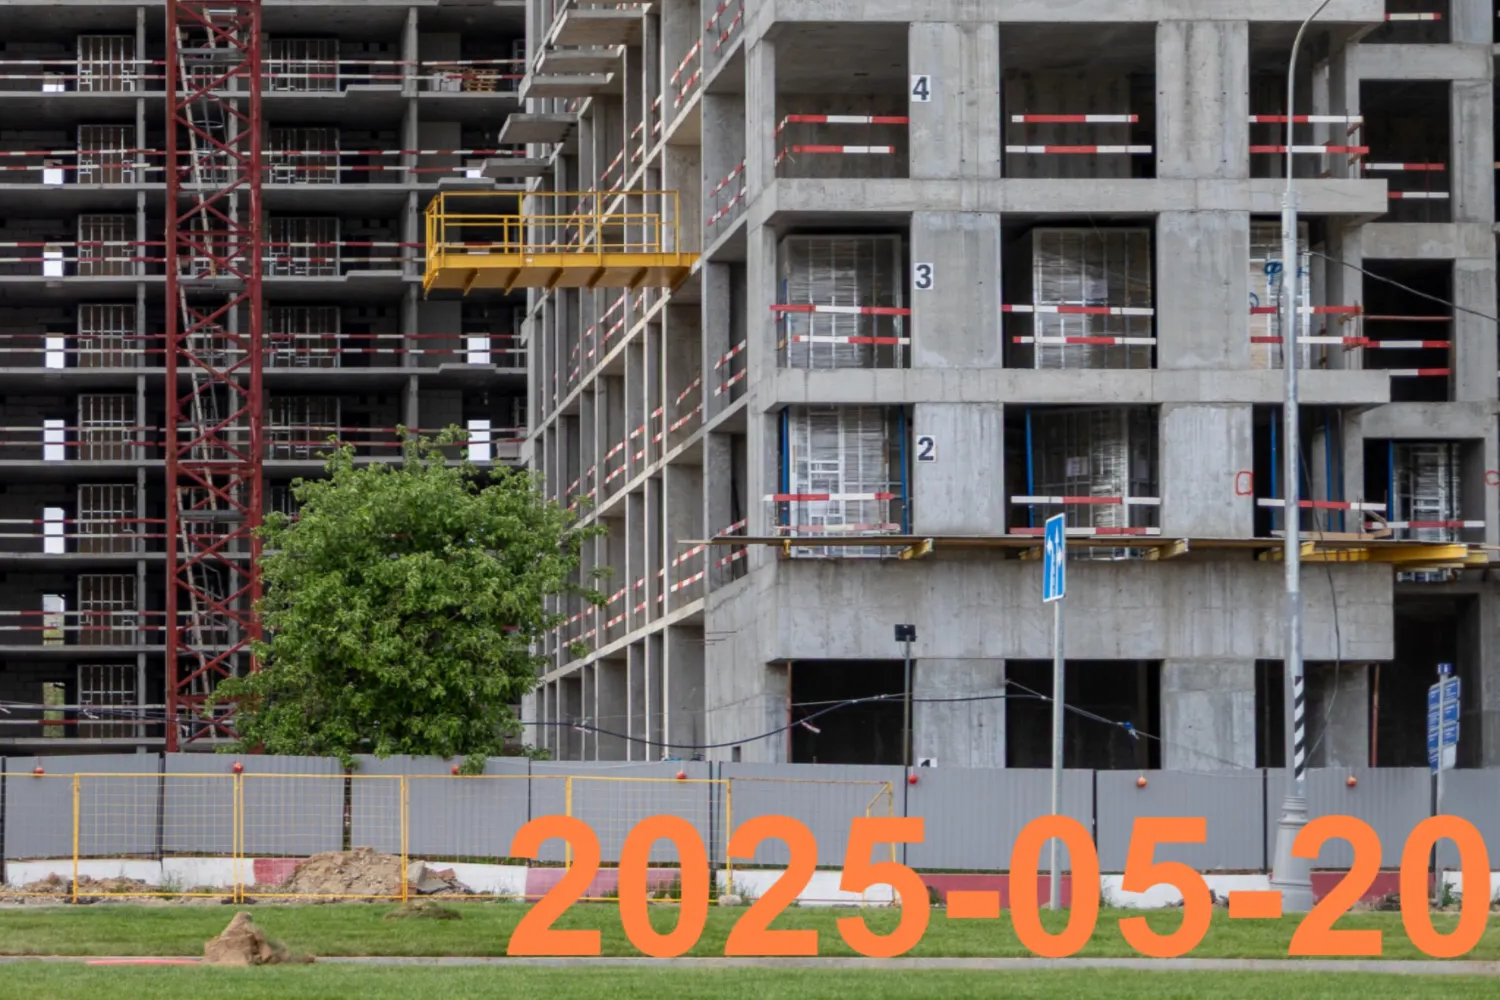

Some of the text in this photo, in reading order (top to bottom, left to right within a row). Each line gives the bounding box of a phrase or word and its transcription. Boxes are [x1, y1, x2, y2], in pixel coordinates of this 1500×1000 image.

[913, 77, 929, 101] 4
[915, 264, 931, 289] 3
[917, 436, 934, 461] 2
